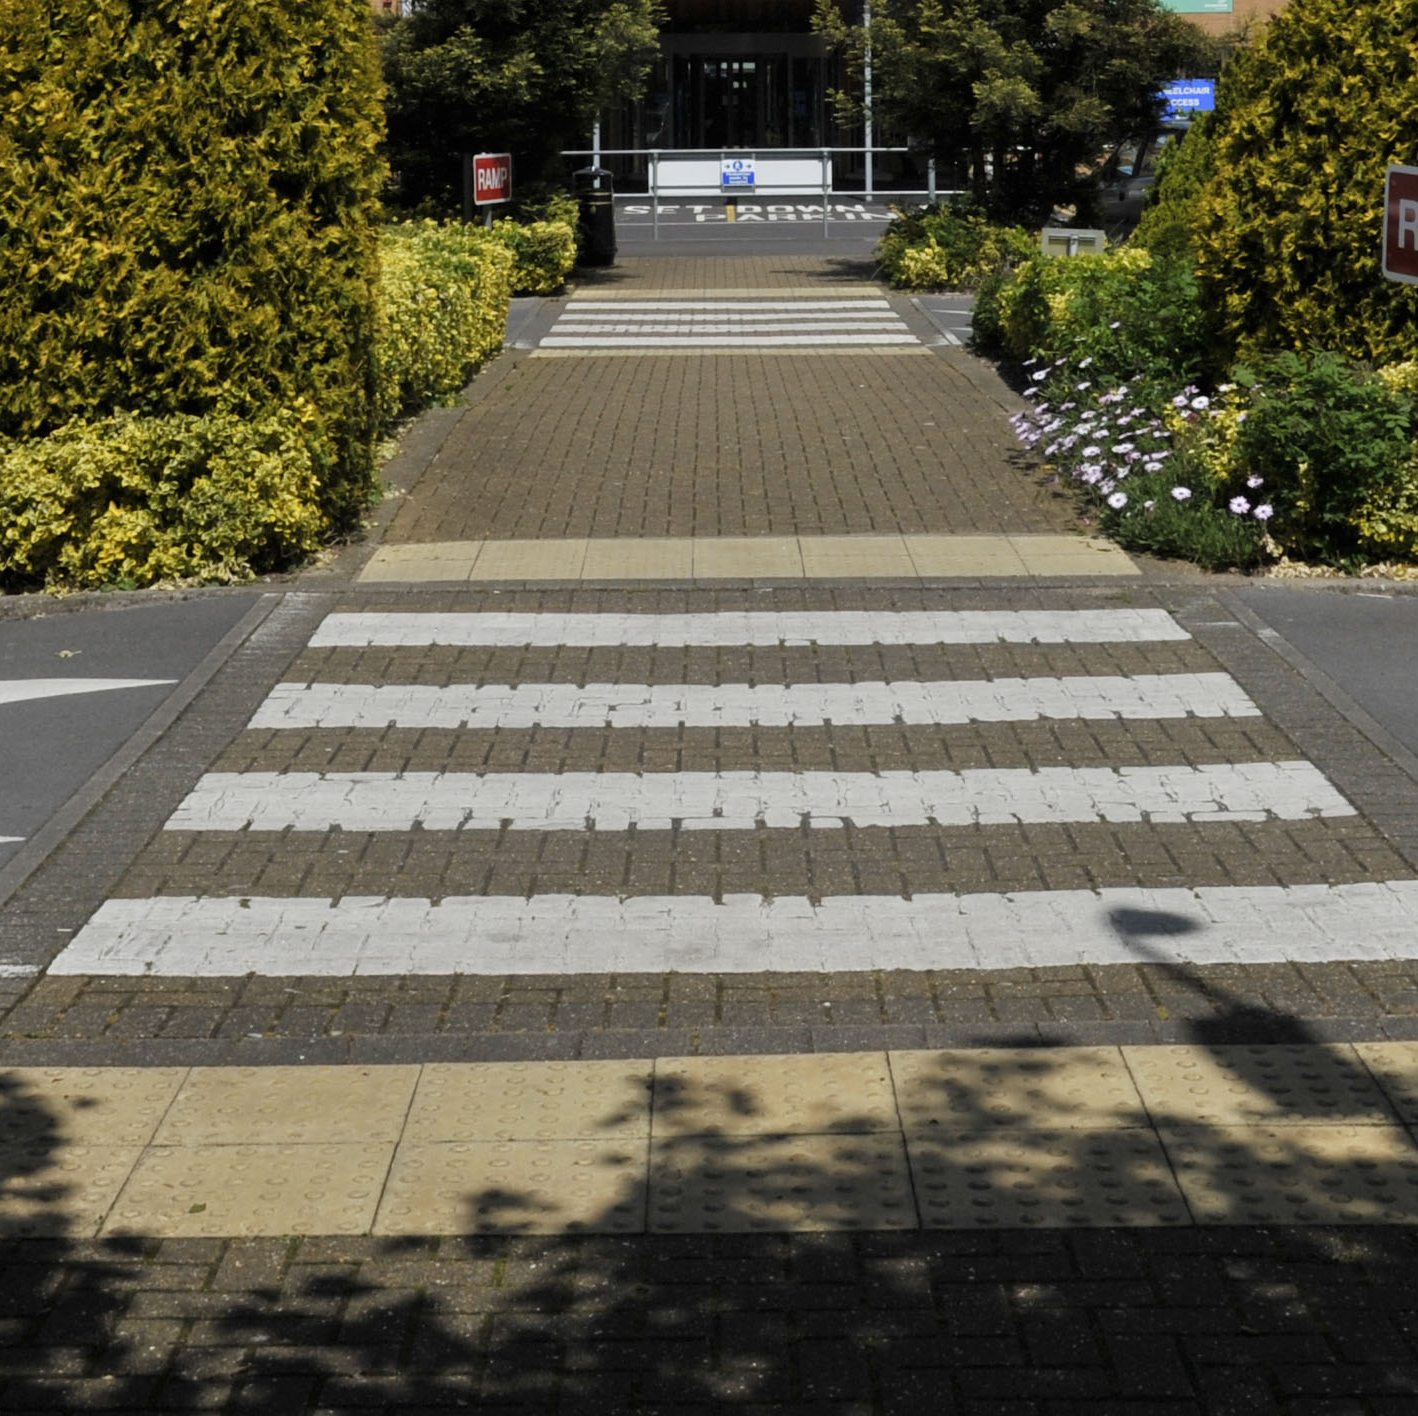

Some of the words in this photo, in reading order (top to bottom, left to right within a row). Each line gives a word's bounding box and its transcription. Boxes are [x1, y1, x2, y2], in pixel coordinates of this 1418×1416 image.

[477, 167, 508, 191] RAMP
[623, 205, 713, 215] SET
[736, 204, 866, 213] DOWN
